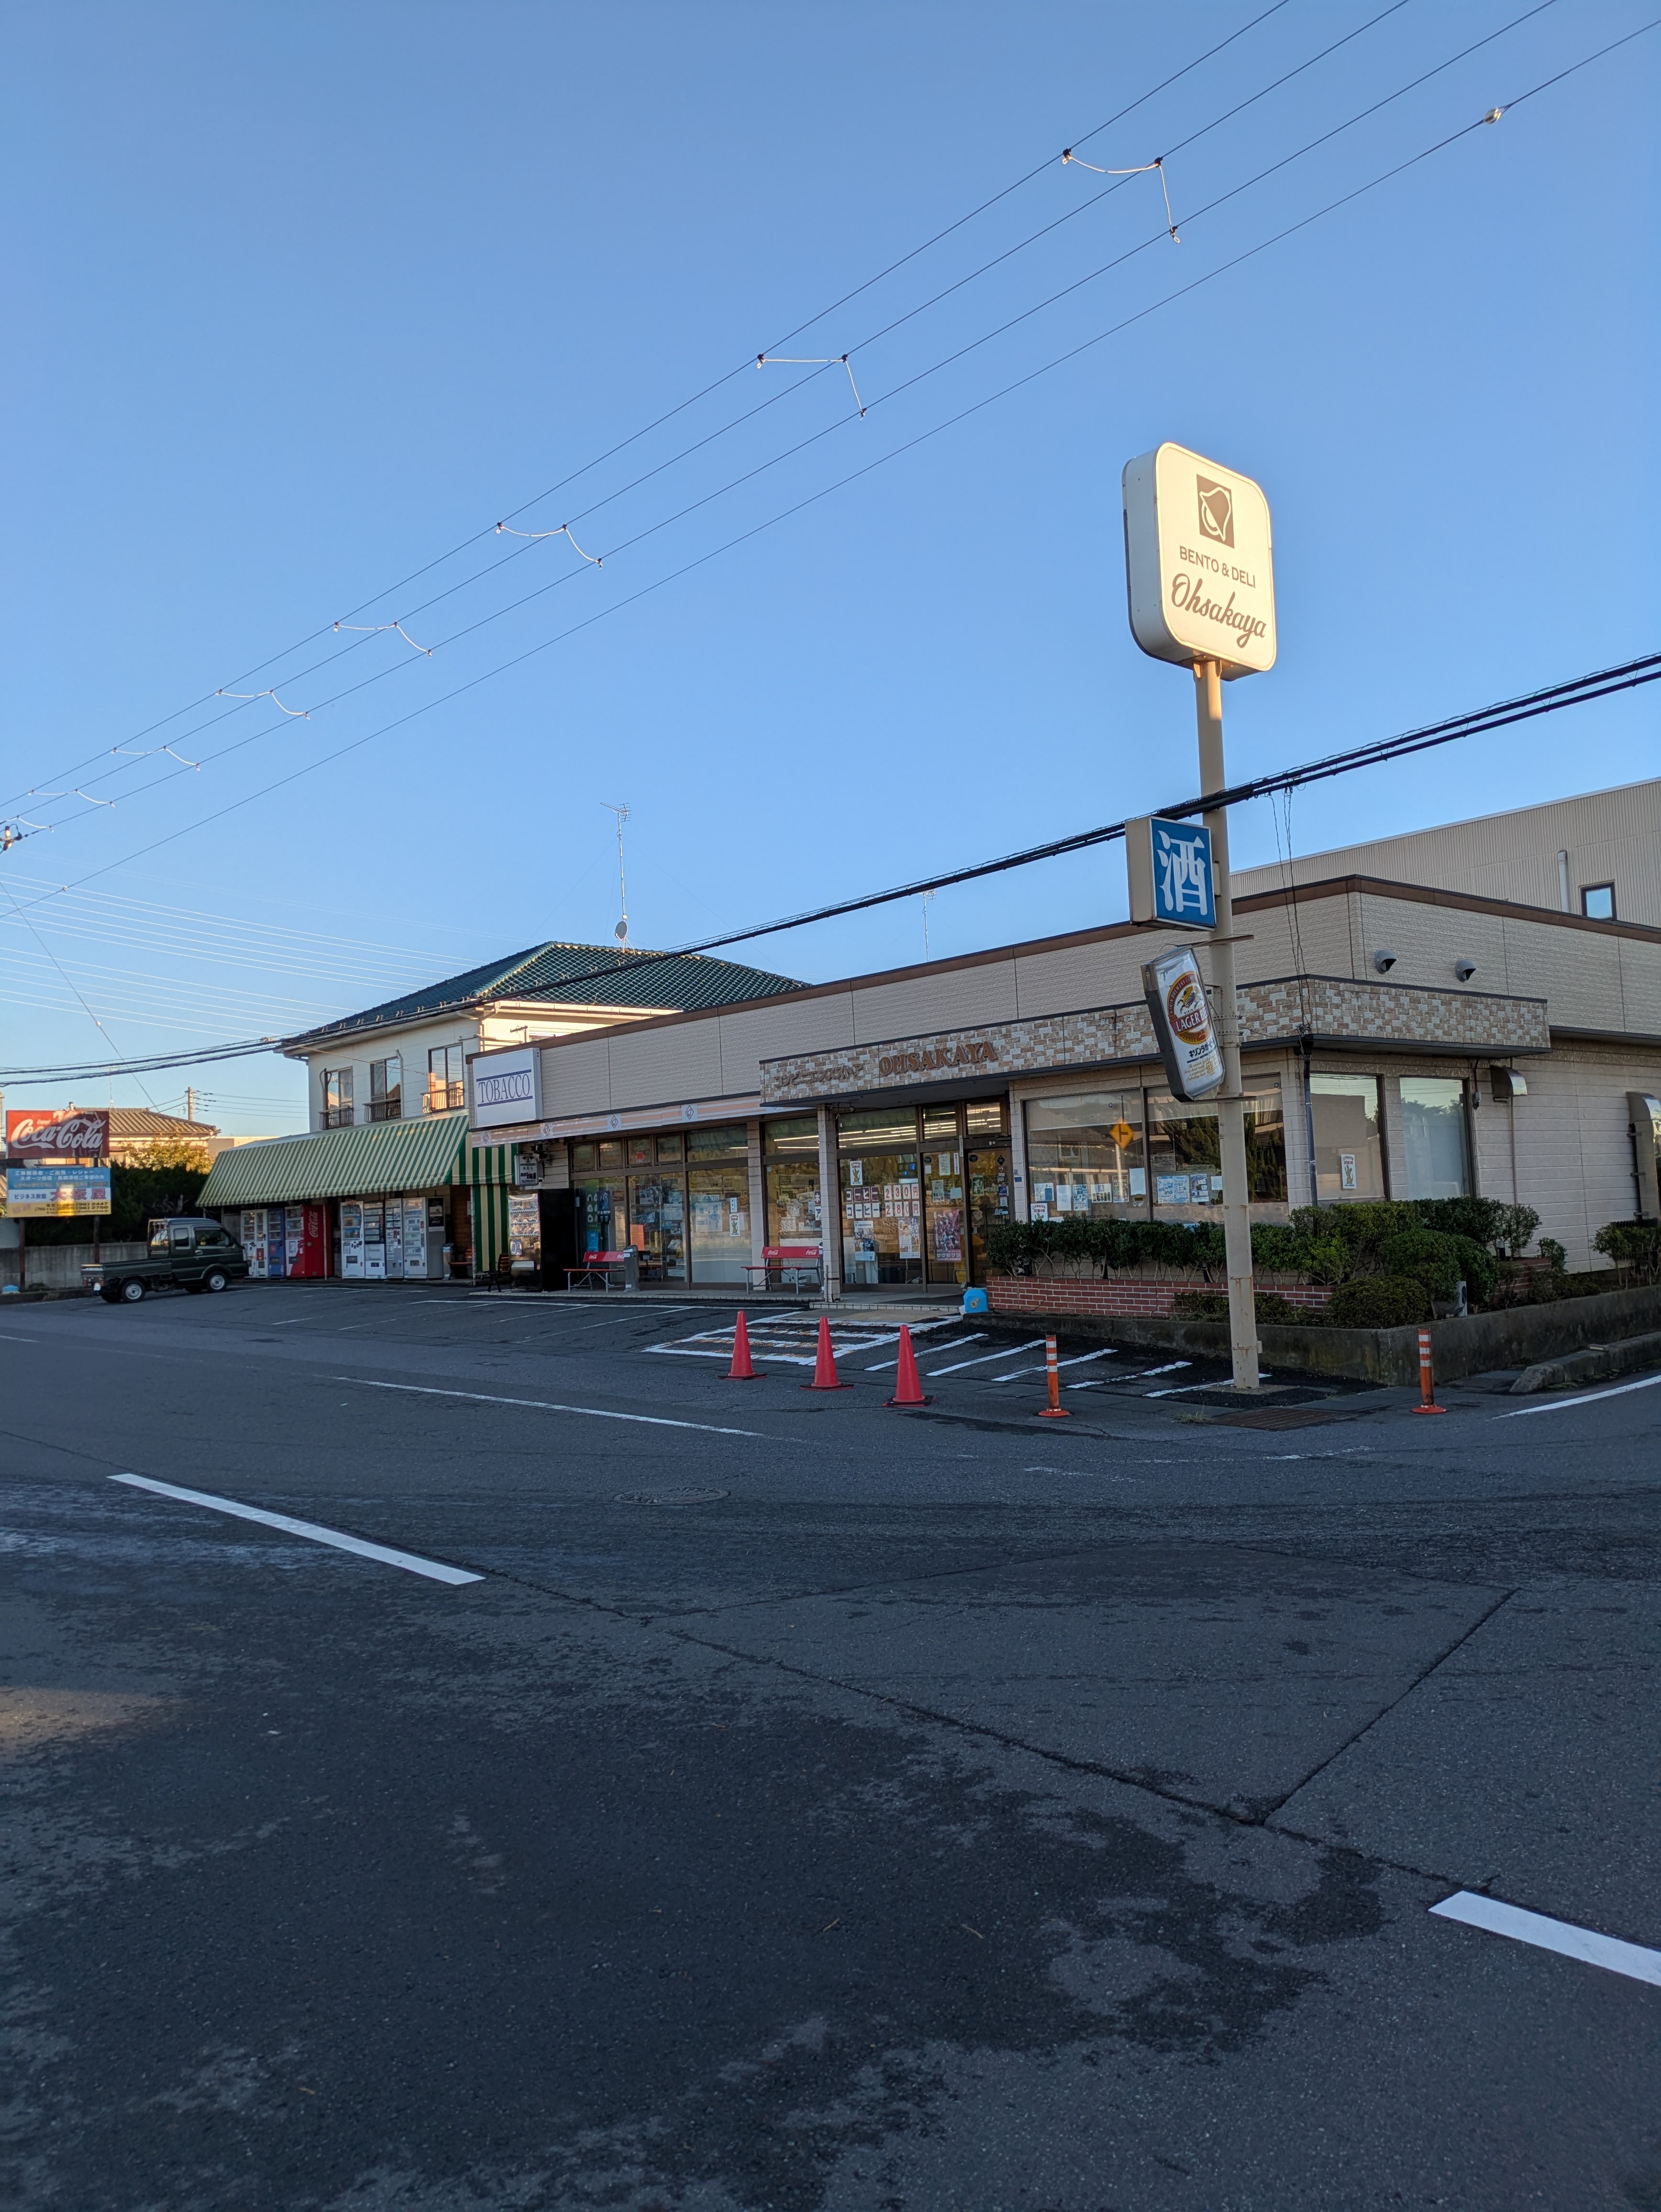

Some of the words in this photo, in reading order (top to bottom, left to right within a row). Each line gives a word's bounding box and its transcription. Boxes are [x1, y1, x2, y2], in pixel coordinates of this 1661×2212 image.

[1180, 545, 1219, 573] BENTO
[1222, 563, 1229, 578] &
[1232, 566, 1256, 588] DELI
[1171, 573, 1267, 649] Ohsakaya
[1157, 830, 1208, 916] 酒
[1176, 1012, 1201, 1032] LAGER
[1200, 1006, 1208, 1021] BE
[879, 1041, 997, 1076] OHSAKAYA
[478, 1073, 530, 1103] TOBACCO
[774, 1064, 865, 1087] コンビニエンスストア
[11, 1119, 106, 1149] Coca-Cola
[50, 1188, 106, 1201] 大坂屋
[846, 1189, 878, 1201] コーヒー
[886, 1186, 919, 1199] 230円
[309, 1210, 318, 1238] Coca-Cola
[847, 1205, 879, 1217] コーヒー
